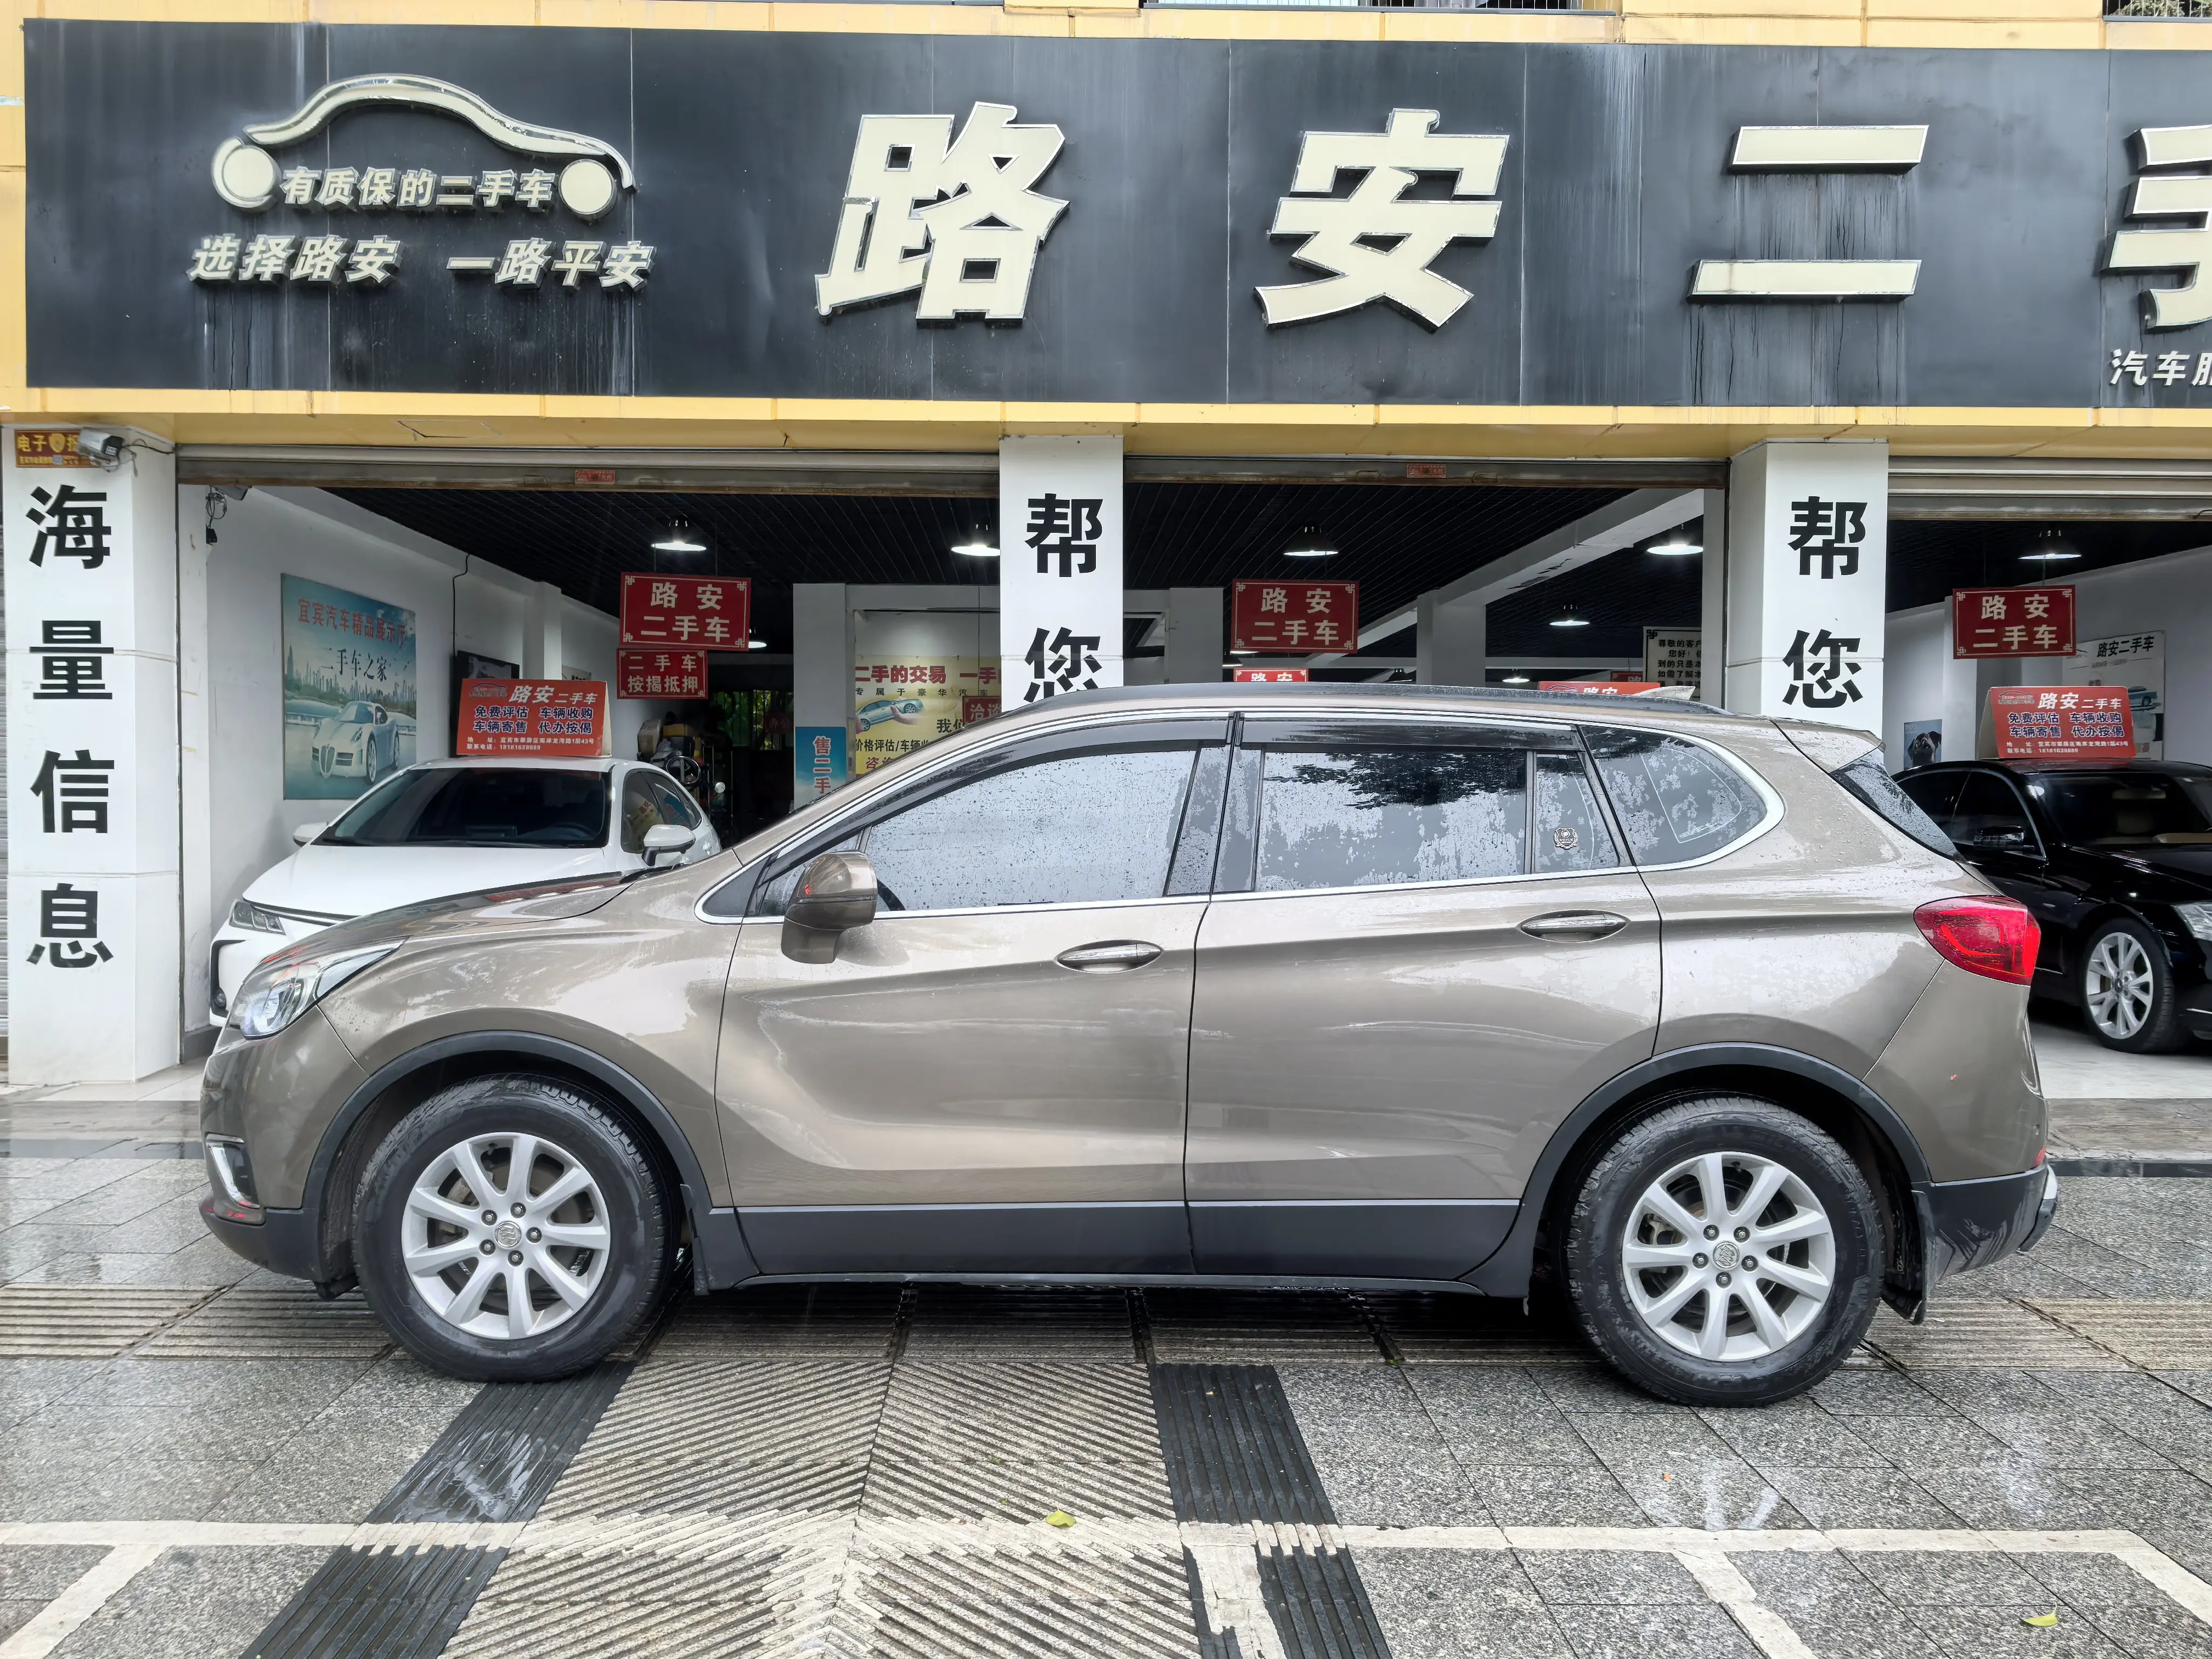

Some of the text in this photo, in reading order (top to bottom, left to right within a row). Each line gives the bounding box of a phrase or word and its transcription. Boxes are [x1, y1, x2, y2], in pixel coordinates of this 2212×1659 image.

[282, 166, 557, 211] 有质保的二手车
[187, 233, 655, 291] 选择路安 一路平安
[650, 582, 723, 610] 路安
[1023, 493, 1103, 703] 帮您
[1260, 587, 1332, 614] 路安
[1782, 496, 1868, 709] 帮您
[1981, 594, 2050, 621] 路安
[640, 615, 730, 643] 二手车
[1252, 619, 1339, 646] 二手车
[1973, 624, 2058, 650] 二手车
[1658, 639, 1702, 648] 尊敬的客户
[2097, 635, 2155, 657] 路安二手车
[321, 647, 387, 682] 二手车之家
[628, 654, 697, 672] 二手车
[855, 665, 1001, 685] 二手的交易 一手
[509, 684, 598, 705] 路安二手车
[627, 675, 698, 693] 按揭抵押
[855, 687, 988, 697] 专属于豪华汽车
[474, 705, 594, 720] 免费评估 车辆收购
[2037, 692, 2122, 710] 路安二手车
[26, 484, 114, 968] 海量信息
[473, 720, 529, 734] 车辆寄售
[2007, 711, 2123, 725] 免费评估 车辆收购
[2009, 725, 2062, 738] 车辆寄售
[812, 736, 832, 795] 售二手
